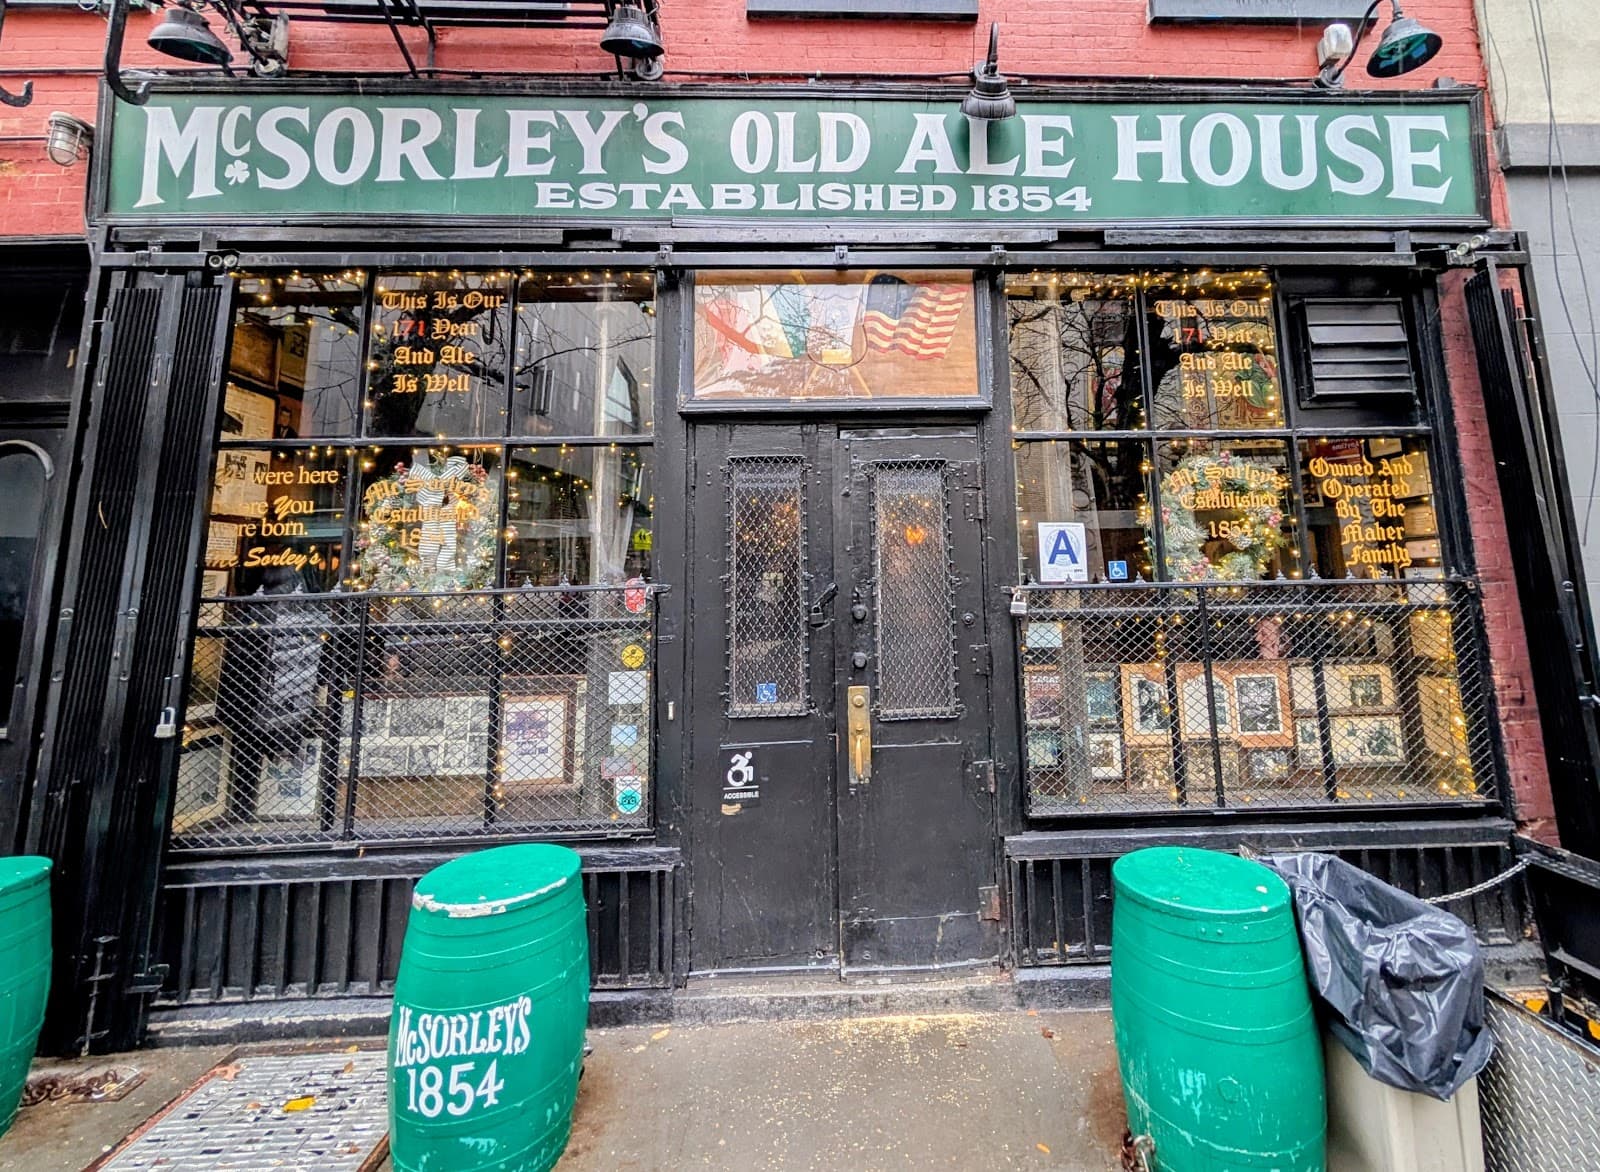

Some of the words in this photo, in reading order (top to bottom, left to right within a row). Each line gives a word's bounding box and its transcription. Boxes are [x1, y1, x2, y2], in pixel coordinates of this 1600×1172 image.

[729, 110, 871, 175] OLD
[895, 112, 1077, 178] ALE
[1111, 114, 1454, 205] HOUSE
[534, 181, 957, 212] ESTABLISHED
[971, 184, 1093, 212] 1854
[382, 290, 428, 311] This
[431, 290, 458, 310] Is
[463, 290, 505, 309] Our
[1153, 299, 1198, 318] This
[1202, 299, 1226, 318] Is
[1230, 299, 1267, 317] Our
[392, 320, 425, 337] 171
[431, 318, 479, 340] Year
[1173, 327, 1204, 344] 171
[1207, 326, 1253, 348] Year
[394, 346, 434, 365] And
[440, 345, 475, 364] Ale
[1179, 352, 1217, 370] And
[1221, 352, 1252, 370] Ale
[392, 373, 418, 393] Is
[423, 373, 471, 392] Well
[1182, 379, 1206, 398] Is
[1211, 379, 1254, 397] Well
[298, 465, 339, 484] here
[1309, 455, 1374, 478] Owned
[1378, 455, 1413, 476] And
[1322, 476, 1410, 502] Operated
[273, 495, 315, 520] You
[1180, 490, 1278, 511] Established
[1335, 499, 1362, 524] By
[1369, 498, 1406, 517] The
[261, 518, 308, 537] born.
[1209, 520, 1254, 539] 1854
[1341, 522, 1405, 545] Maher
[1047, 529, 1079, 565] A
[1345, 542, 1412, 569] Family
[243, 545, 322, 572] Sorley's
[723, 790, 759, 800] ACCESSIBLE
[407, 1058, 505, 1118] 1854
